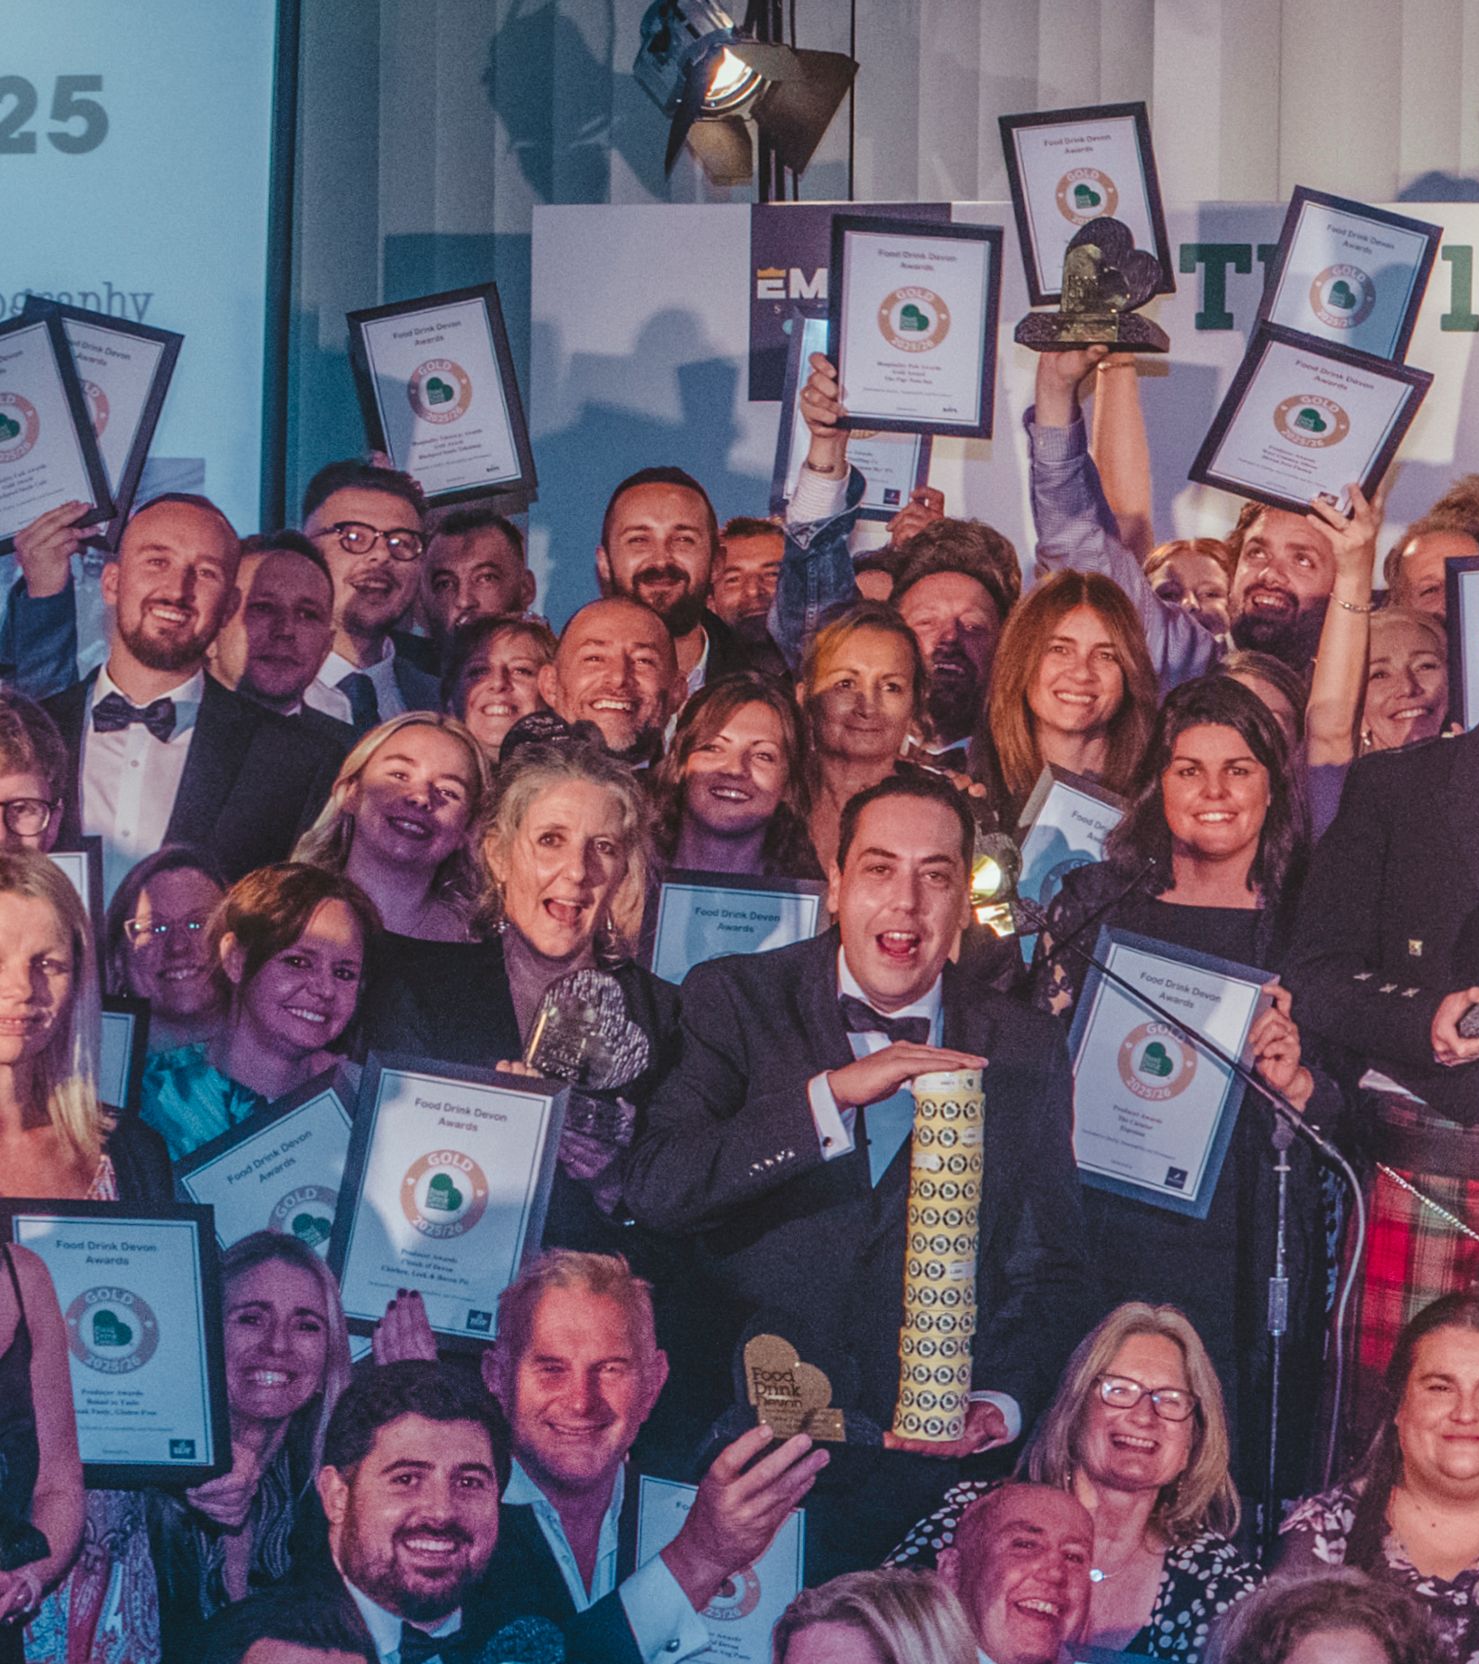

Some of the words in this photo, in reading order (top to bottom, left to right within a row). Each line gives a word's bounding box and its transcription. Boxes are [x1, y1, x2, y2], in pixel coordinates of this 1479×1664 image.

[413, 1097, 442, 1111] Food
[442, 1102, 471, 1115] Drink
[473, 1107, 508, 1122] Devon
[437, 1116, 479, 1132] Awards
[428, 1153, 473, 1171] GOLD
[414, 1217, 463, 1236] 2025/26
[55, 1239, 84, 1249] Food
[86, 1240, 118, 1251] Drink
[120, 1241, 156, 1252] Devon
[85, 1255, 129, 1265] Awards
[752, 1367, 795, 1382] Food
[755, 1382, 802, 1397] Drink
